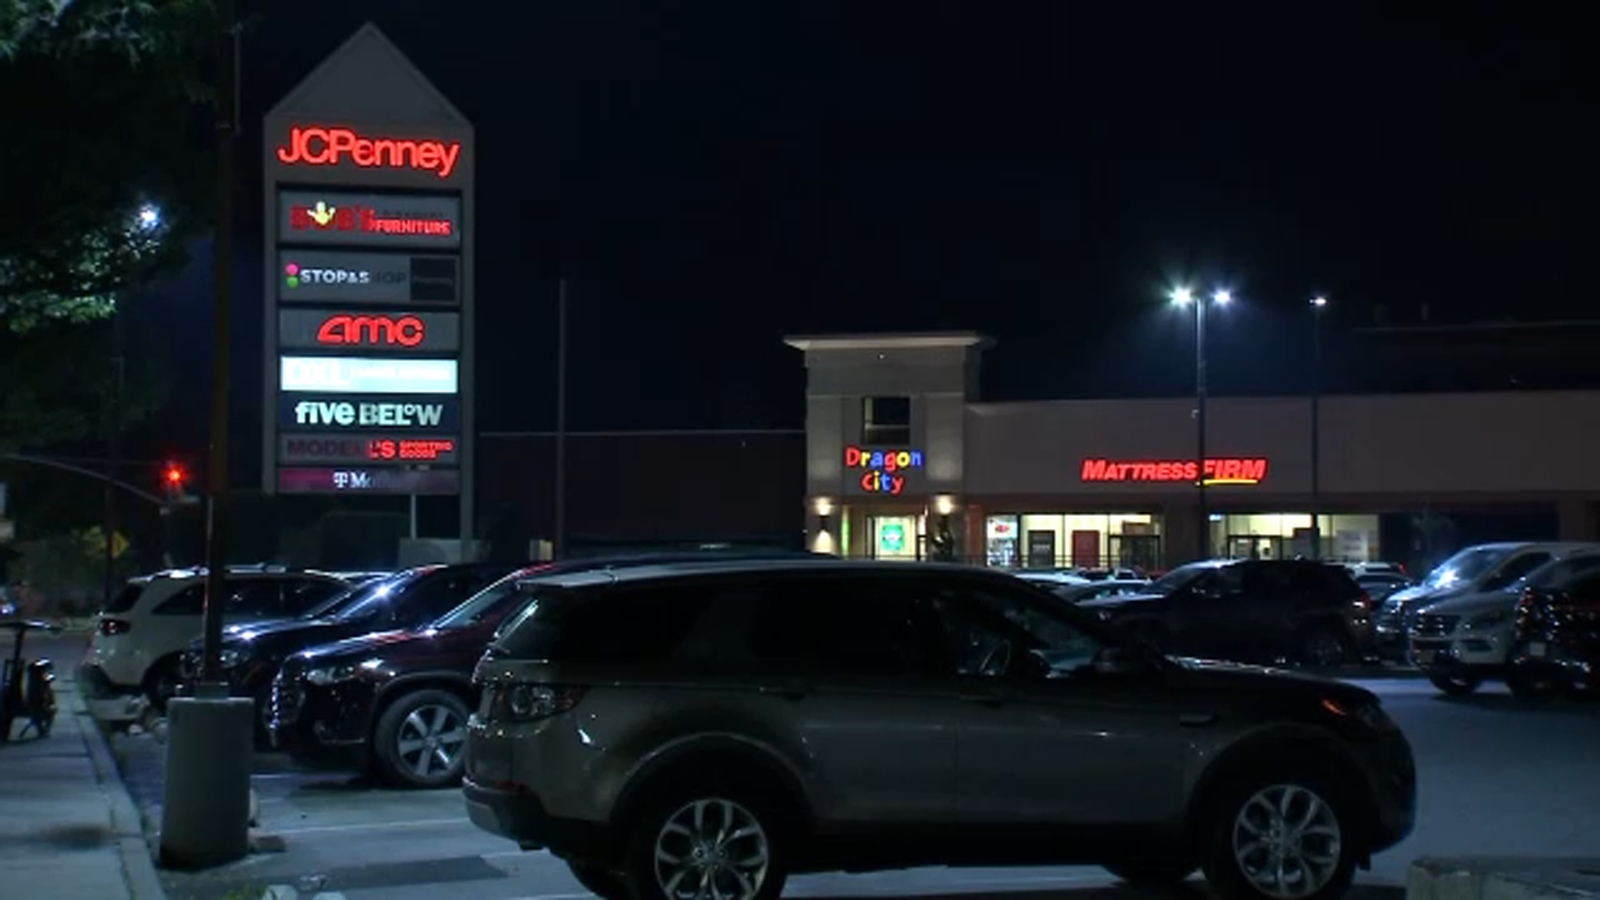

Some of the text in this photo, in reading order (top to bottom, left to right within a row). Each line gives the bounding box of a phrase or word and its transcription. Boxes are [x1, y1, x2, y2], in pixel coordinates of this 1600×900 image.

[279, 127, 459, 177] JCPenney
[376, 219, 452, 236] FURNITURE
[295, 401, 443, 425] five BELOW
[845, 446, 923, 472] Dragon
[1202, 458, 1266, 480] FIRM
[861, 471, 904, 496] City
